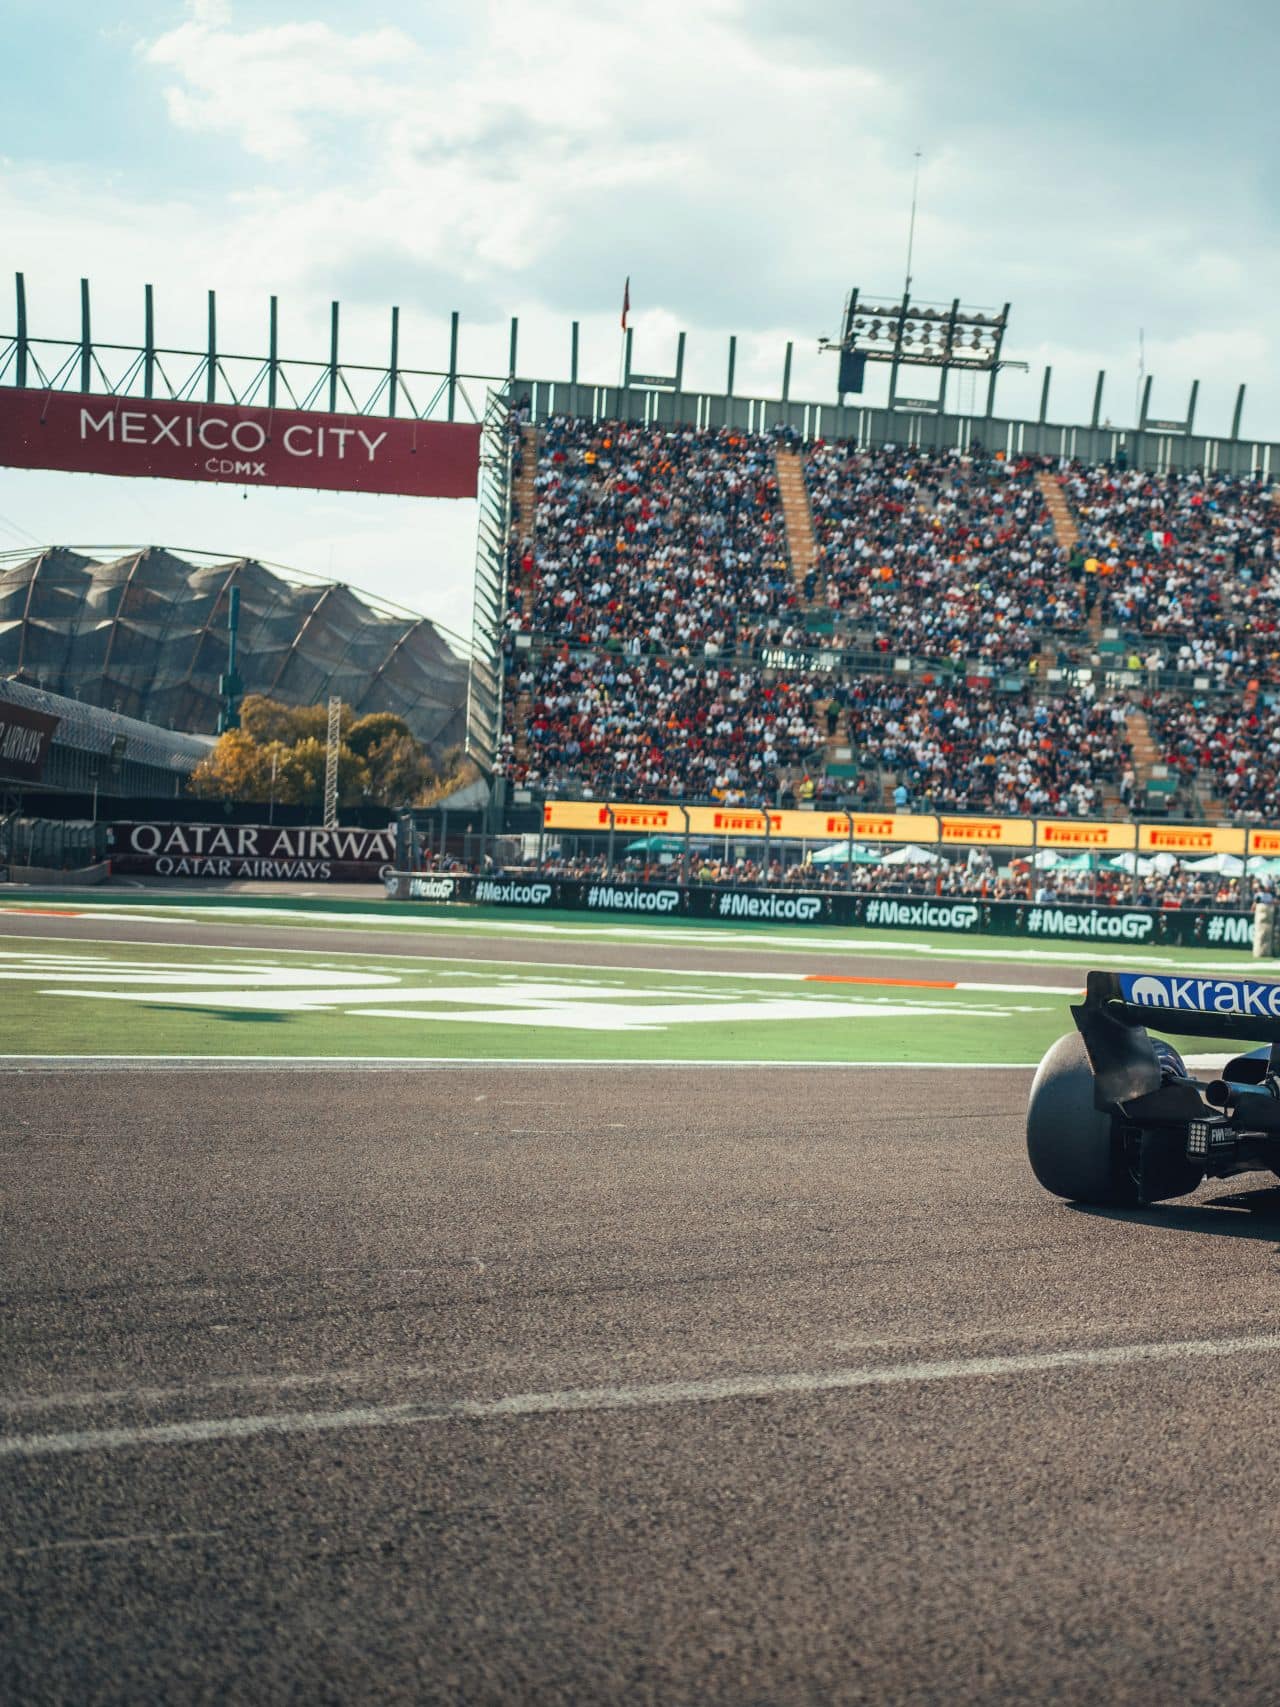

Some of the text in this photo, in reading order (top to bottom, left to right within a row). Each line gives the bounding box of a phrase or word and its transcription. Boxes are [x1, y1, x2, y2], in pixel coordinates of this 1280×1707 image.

[80, 408, 387, 461] MEXICO CITY
[205, 457, 267, 477] CDMX
[599, 807, 668, 826] PRELLI
[130, 825, 259, 855] QATAR
[155, 857, 331, 879] QATAR AIRWAYS
[475, 879, 552, 904] #MexicoGP
[588, 885, 679, 911] #MexicoGP
[719, 894, 821, 919] #MexicoGP
[866, 900, 979, 928] #MexicoGP
[1027, 908, 1153, 938] #MexicoGP
